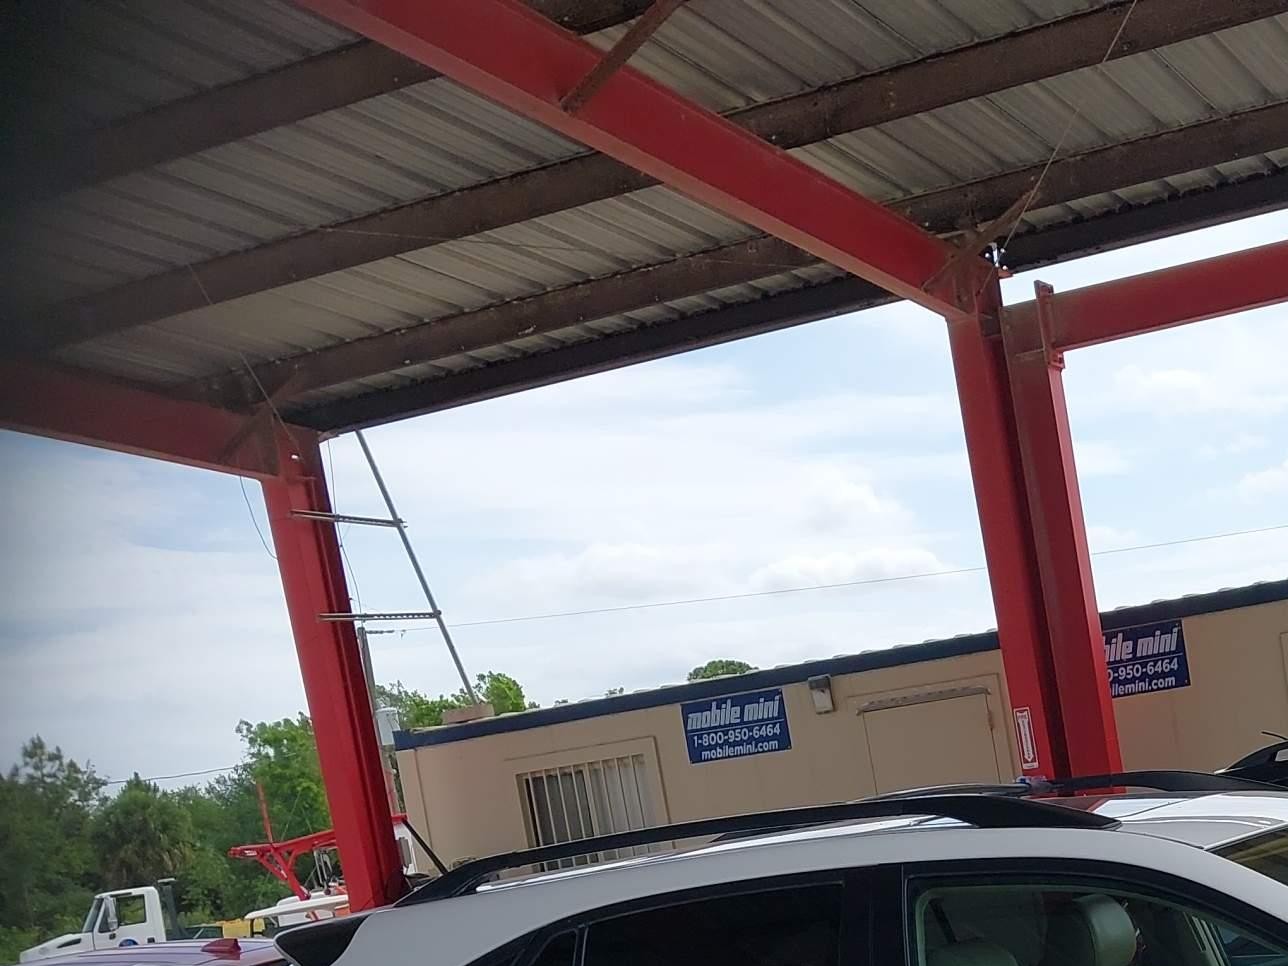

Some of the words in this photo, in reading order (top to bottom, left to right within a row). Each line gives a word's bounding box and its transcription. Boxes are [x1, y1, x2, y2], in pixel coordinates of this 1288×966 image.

[1136, 626, 1178, 657] mini
[1107, 657, 1178, 682] 0-950-6464
[1110, 676, 1176, 697] ilemini.com
[687, 699, 741, 730] mobile
[743, 695, 780, 722] mini
[693, 723, 781, 748] 1-800-950-6464
[701, 740, 779, 761] mobilemini.com
